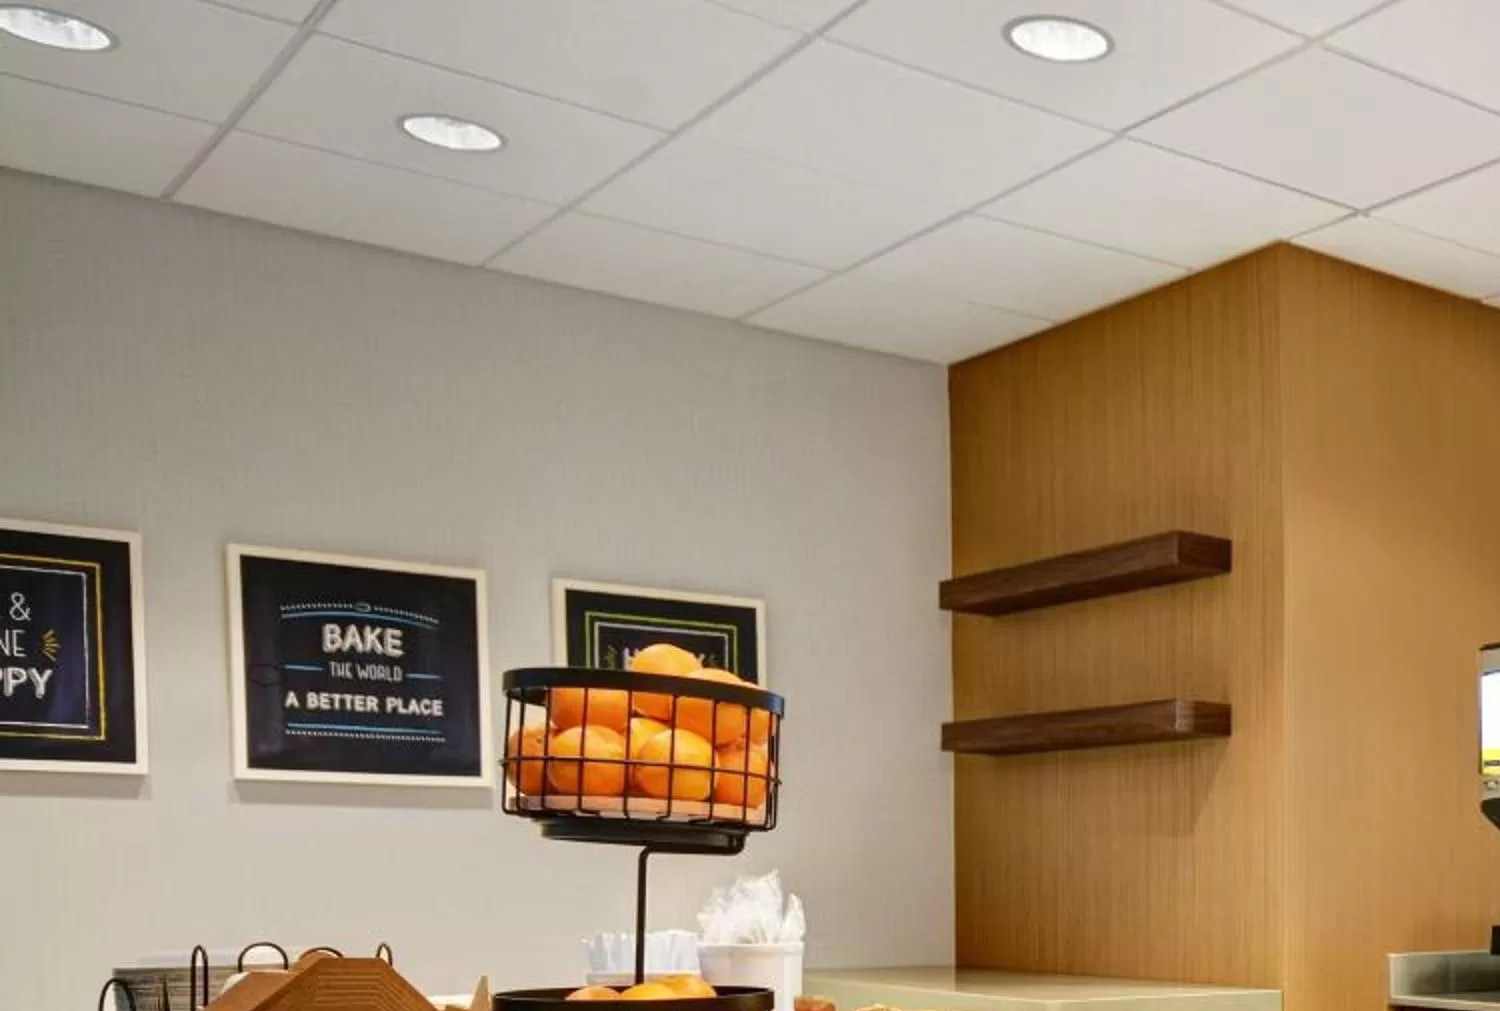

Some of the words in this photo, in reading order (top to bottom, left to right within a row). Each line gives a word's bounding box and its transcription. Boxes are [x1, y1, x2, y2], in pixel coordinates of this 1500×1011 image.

[321, 622, 405, 658] BAKE
[328, 661, 353, 679] THE
[355, 663, 404, 682] WORLD
[284, 690, 300, 709] A
[305, 691, 380, 714] BETTER
[384, 696, 444, 717] PLACE
